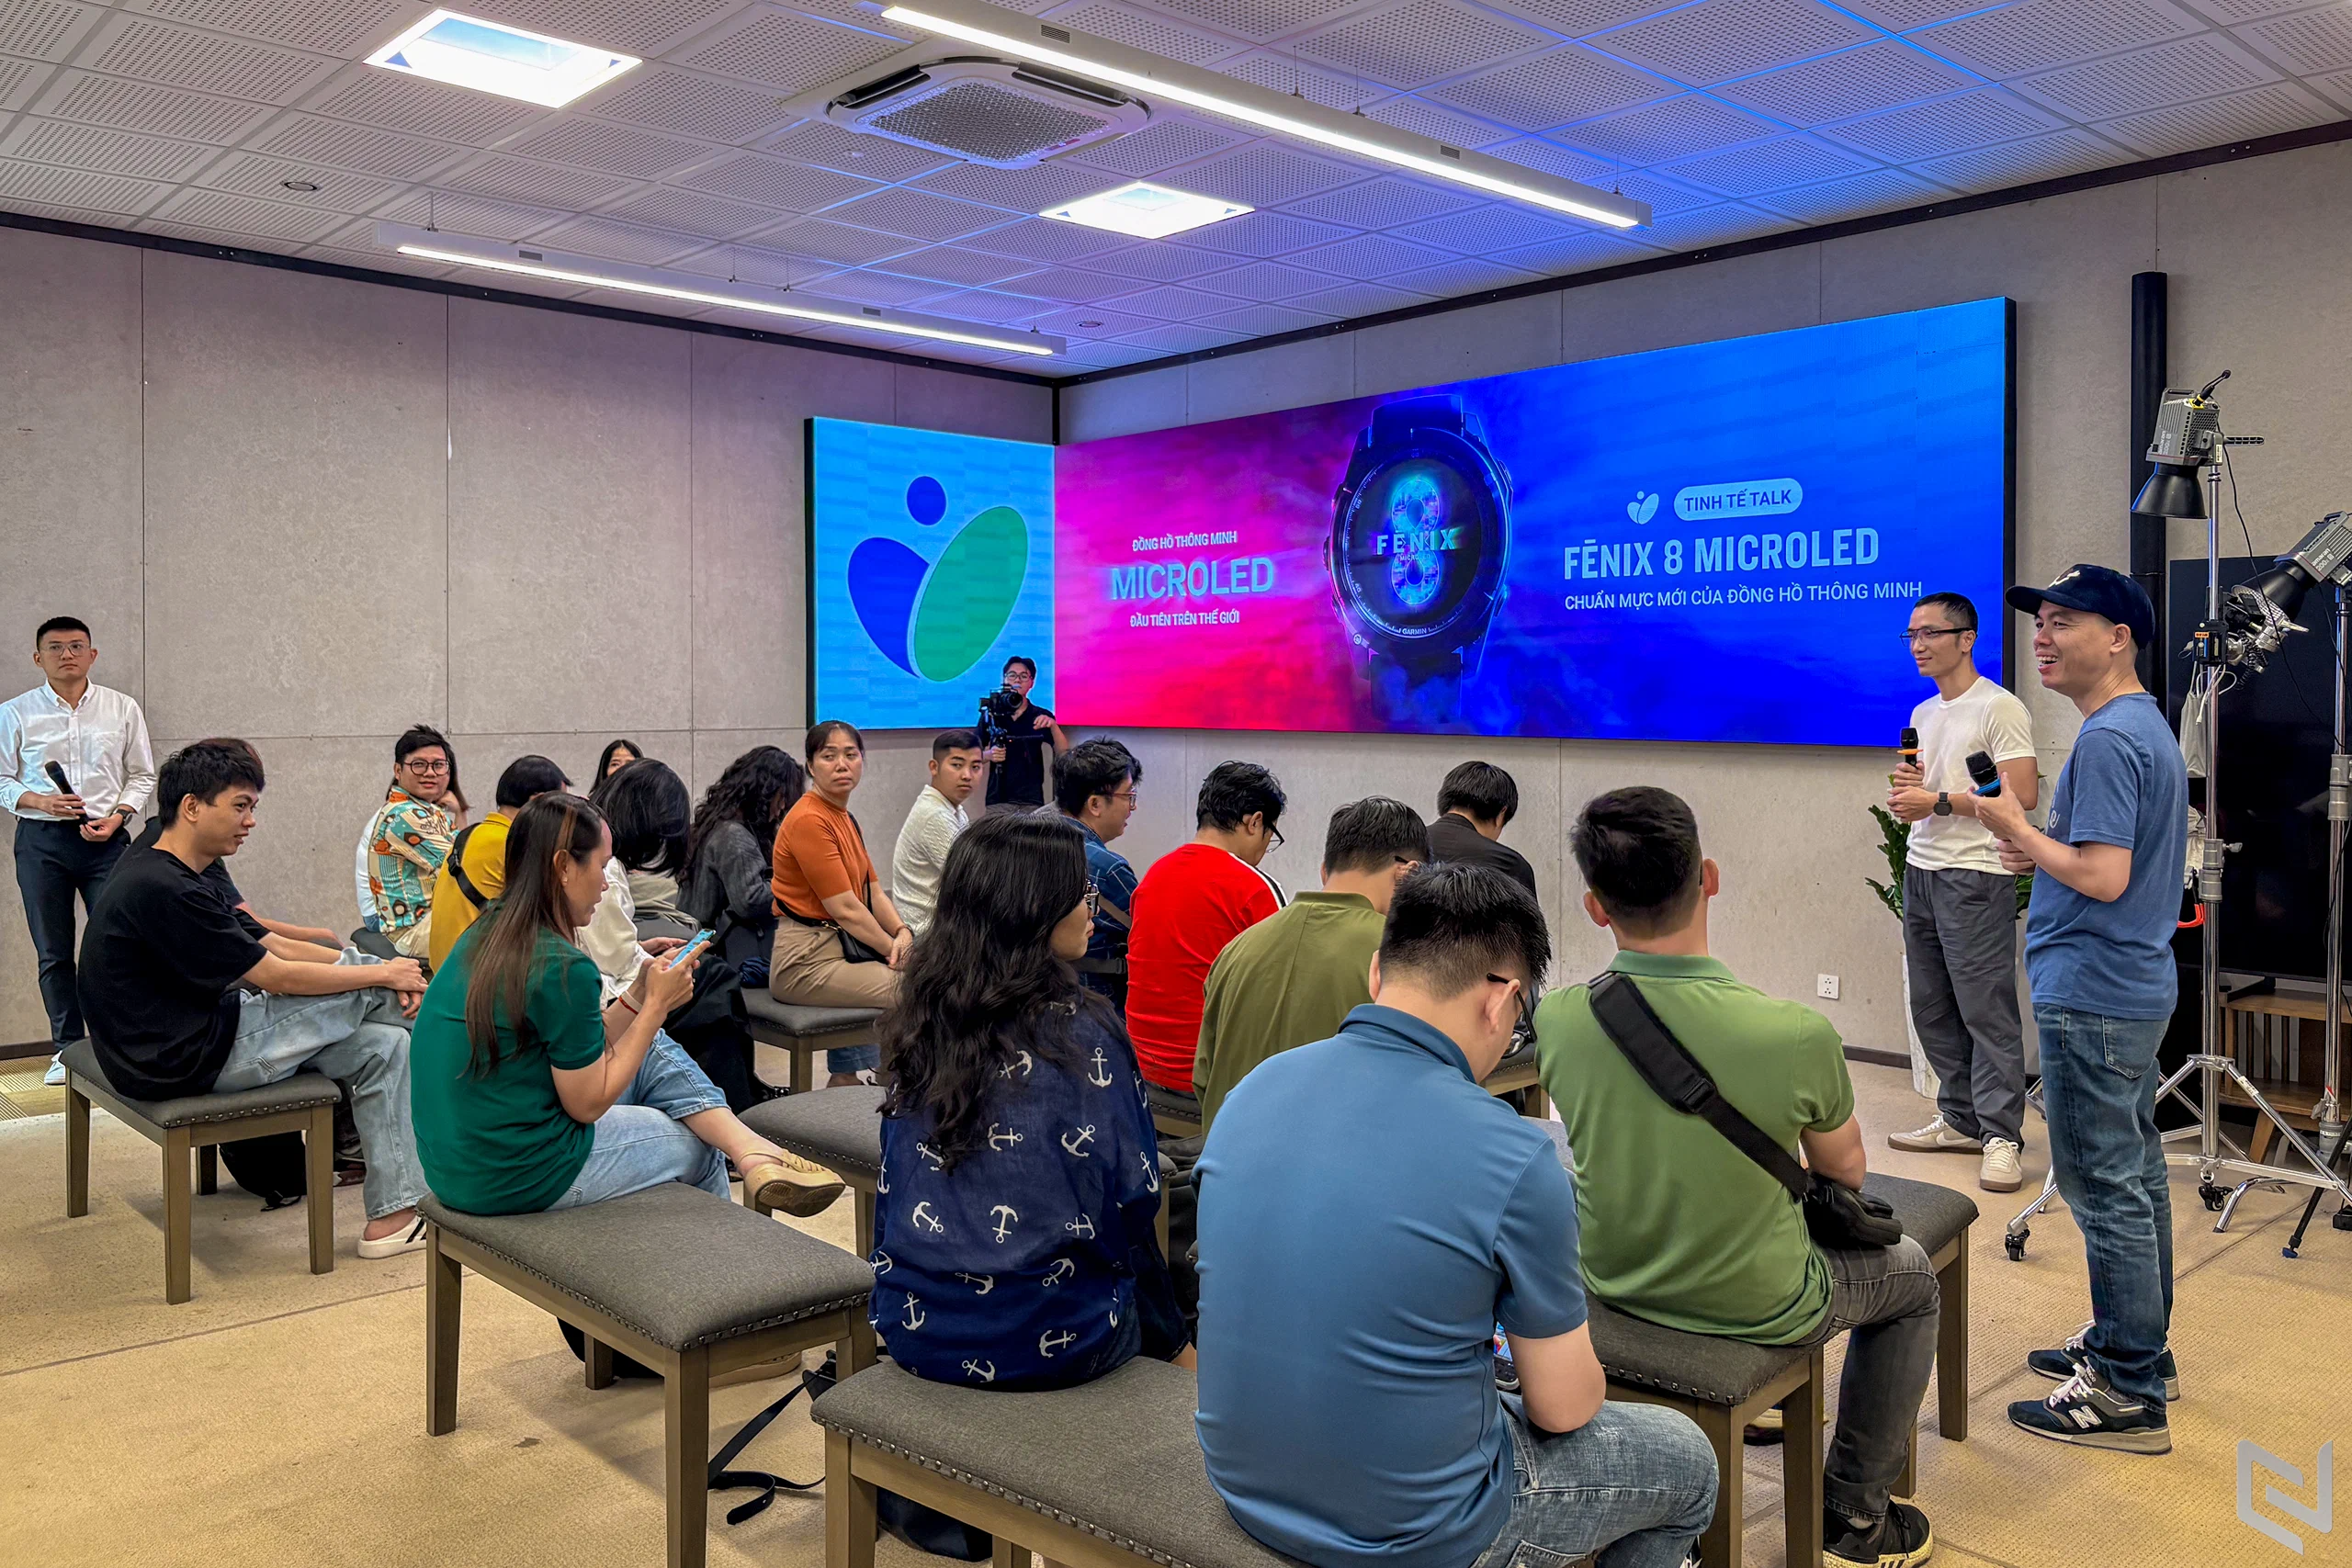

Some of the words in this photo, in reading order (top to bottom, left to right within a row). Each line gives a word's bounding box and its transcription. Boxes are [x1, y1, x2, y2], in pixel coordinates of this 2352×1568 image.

[1684, 496, 1722, 512] TINH
[1726, 489, 1748, 508] TẾ
[1749, 489, 1792, 506] TALK
[1132, 536, 1159, 551] ĐỒNG
[1159, 533, 1174, 549] HỒ
[1174, 532, 1208, 548] THÔNG
[1210, 530, 1238, 545] MINH
[1564, 539, 1654, 580] FĒNIX
[1664, 539, 1683, 575] 8
[1694, 527, 1879, 573] MICROLED
[1111, 557, 1274, 600] MICROLED
[1565, 590, 1615, 610] CHUẨN
[1620, 592, 1654, 610] MỰC
[1657, 588, 1687, 606] MỚI
[1690, 585, 1724, 604] CỦA
[1726, 583, 1774, 604] ĐỒNG
[1779, 581, 1804, 602] HỒ
[1806, 581, 1869, 601] THÔNG
[1873, 581, 1922, 598] MINH
[1130, 612, 1148, 627] ĐẦU
[1149, 611, 1171, 626] TIÊN
[1172, 610, 1197, 626] TRÊN
[1198, 608, 1218, 625] THẾ
[1219, 607, 1240, 624] GIỚI
[1402, 627, 1427, 636] GARMIN
